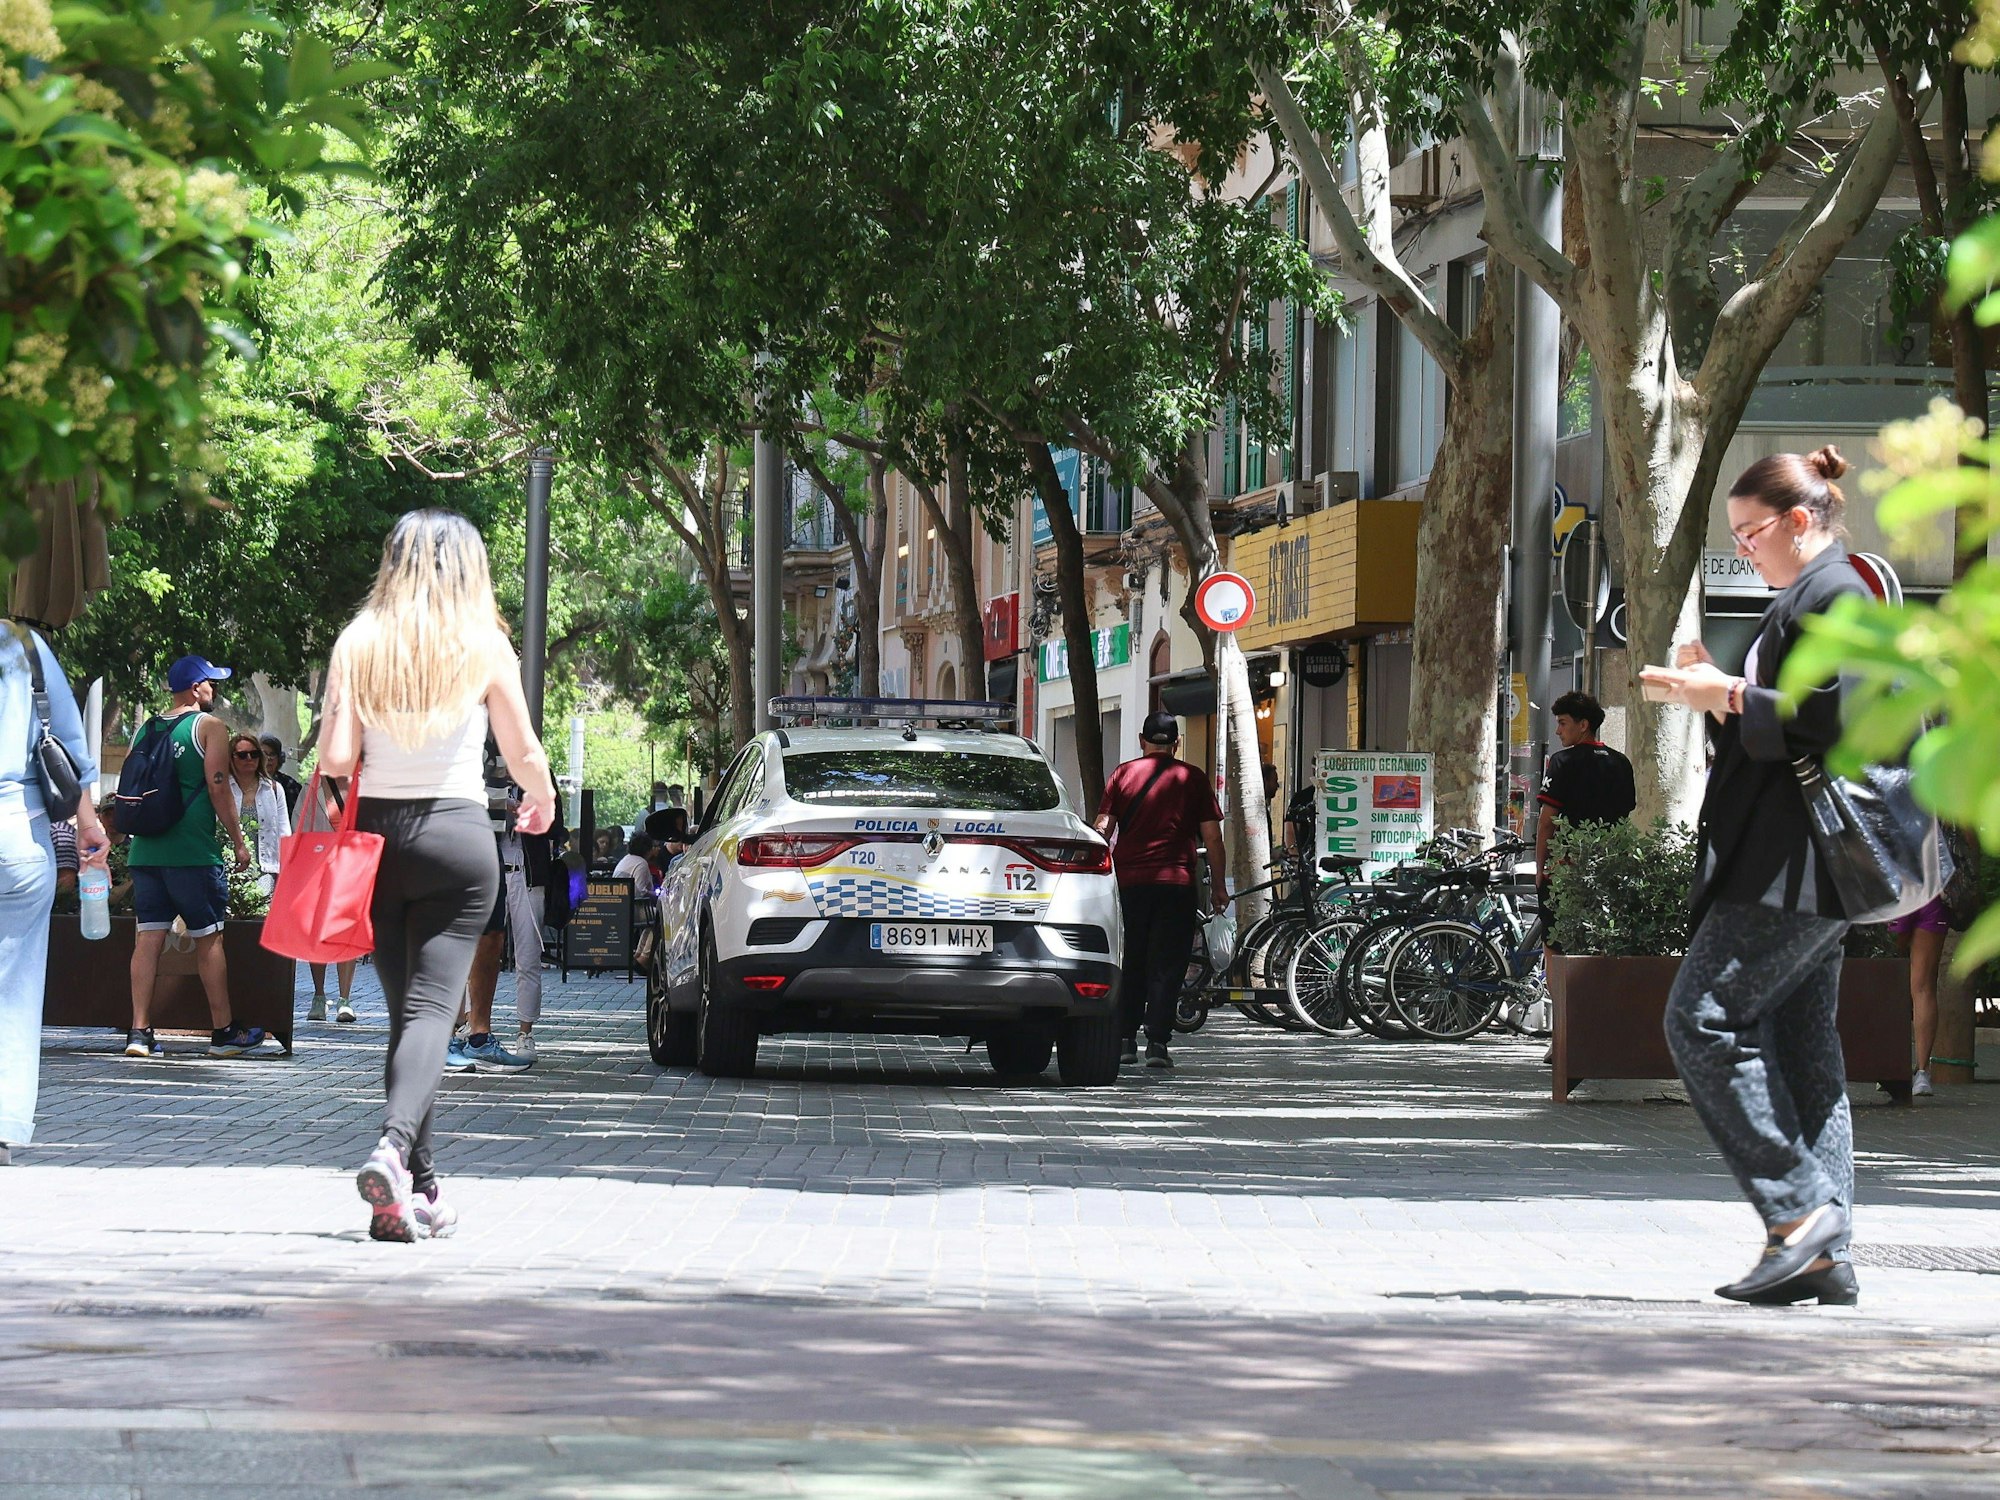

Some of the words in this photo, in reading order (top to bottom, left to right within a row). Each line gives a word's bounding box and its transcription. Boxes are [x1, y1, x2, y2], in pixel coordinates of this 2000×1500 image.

[1711, 558, 1725, 575] DE
[1728, 559, 1755, 575] JOAN
[1268, 541, 1278, 628] ES
[1045, 639, 1060, 681] ONE
[1306, 663, 1341, 674] BURGER
[1323, 757, 1376, 772] LOCUTORIO
[1378, 757, 1427, 772] GERANIOS
[854, 819, 919, 832] POLICIA
[1370, 812, 1389, 823] SIM
[1392, 812, 1423, 824] CARDS
[954, 821, 1006, 834] LOCAL
[1370, 830, 1428, 844] FOTOCOPIAS
[850, 850, 876, 865] T20
[874, 864, 991, 875] ARKANA
[1004, 873, 1037, 891] 112
[886, 927, 938, 946] 8691
[947, 928, 988, 948] MHX
